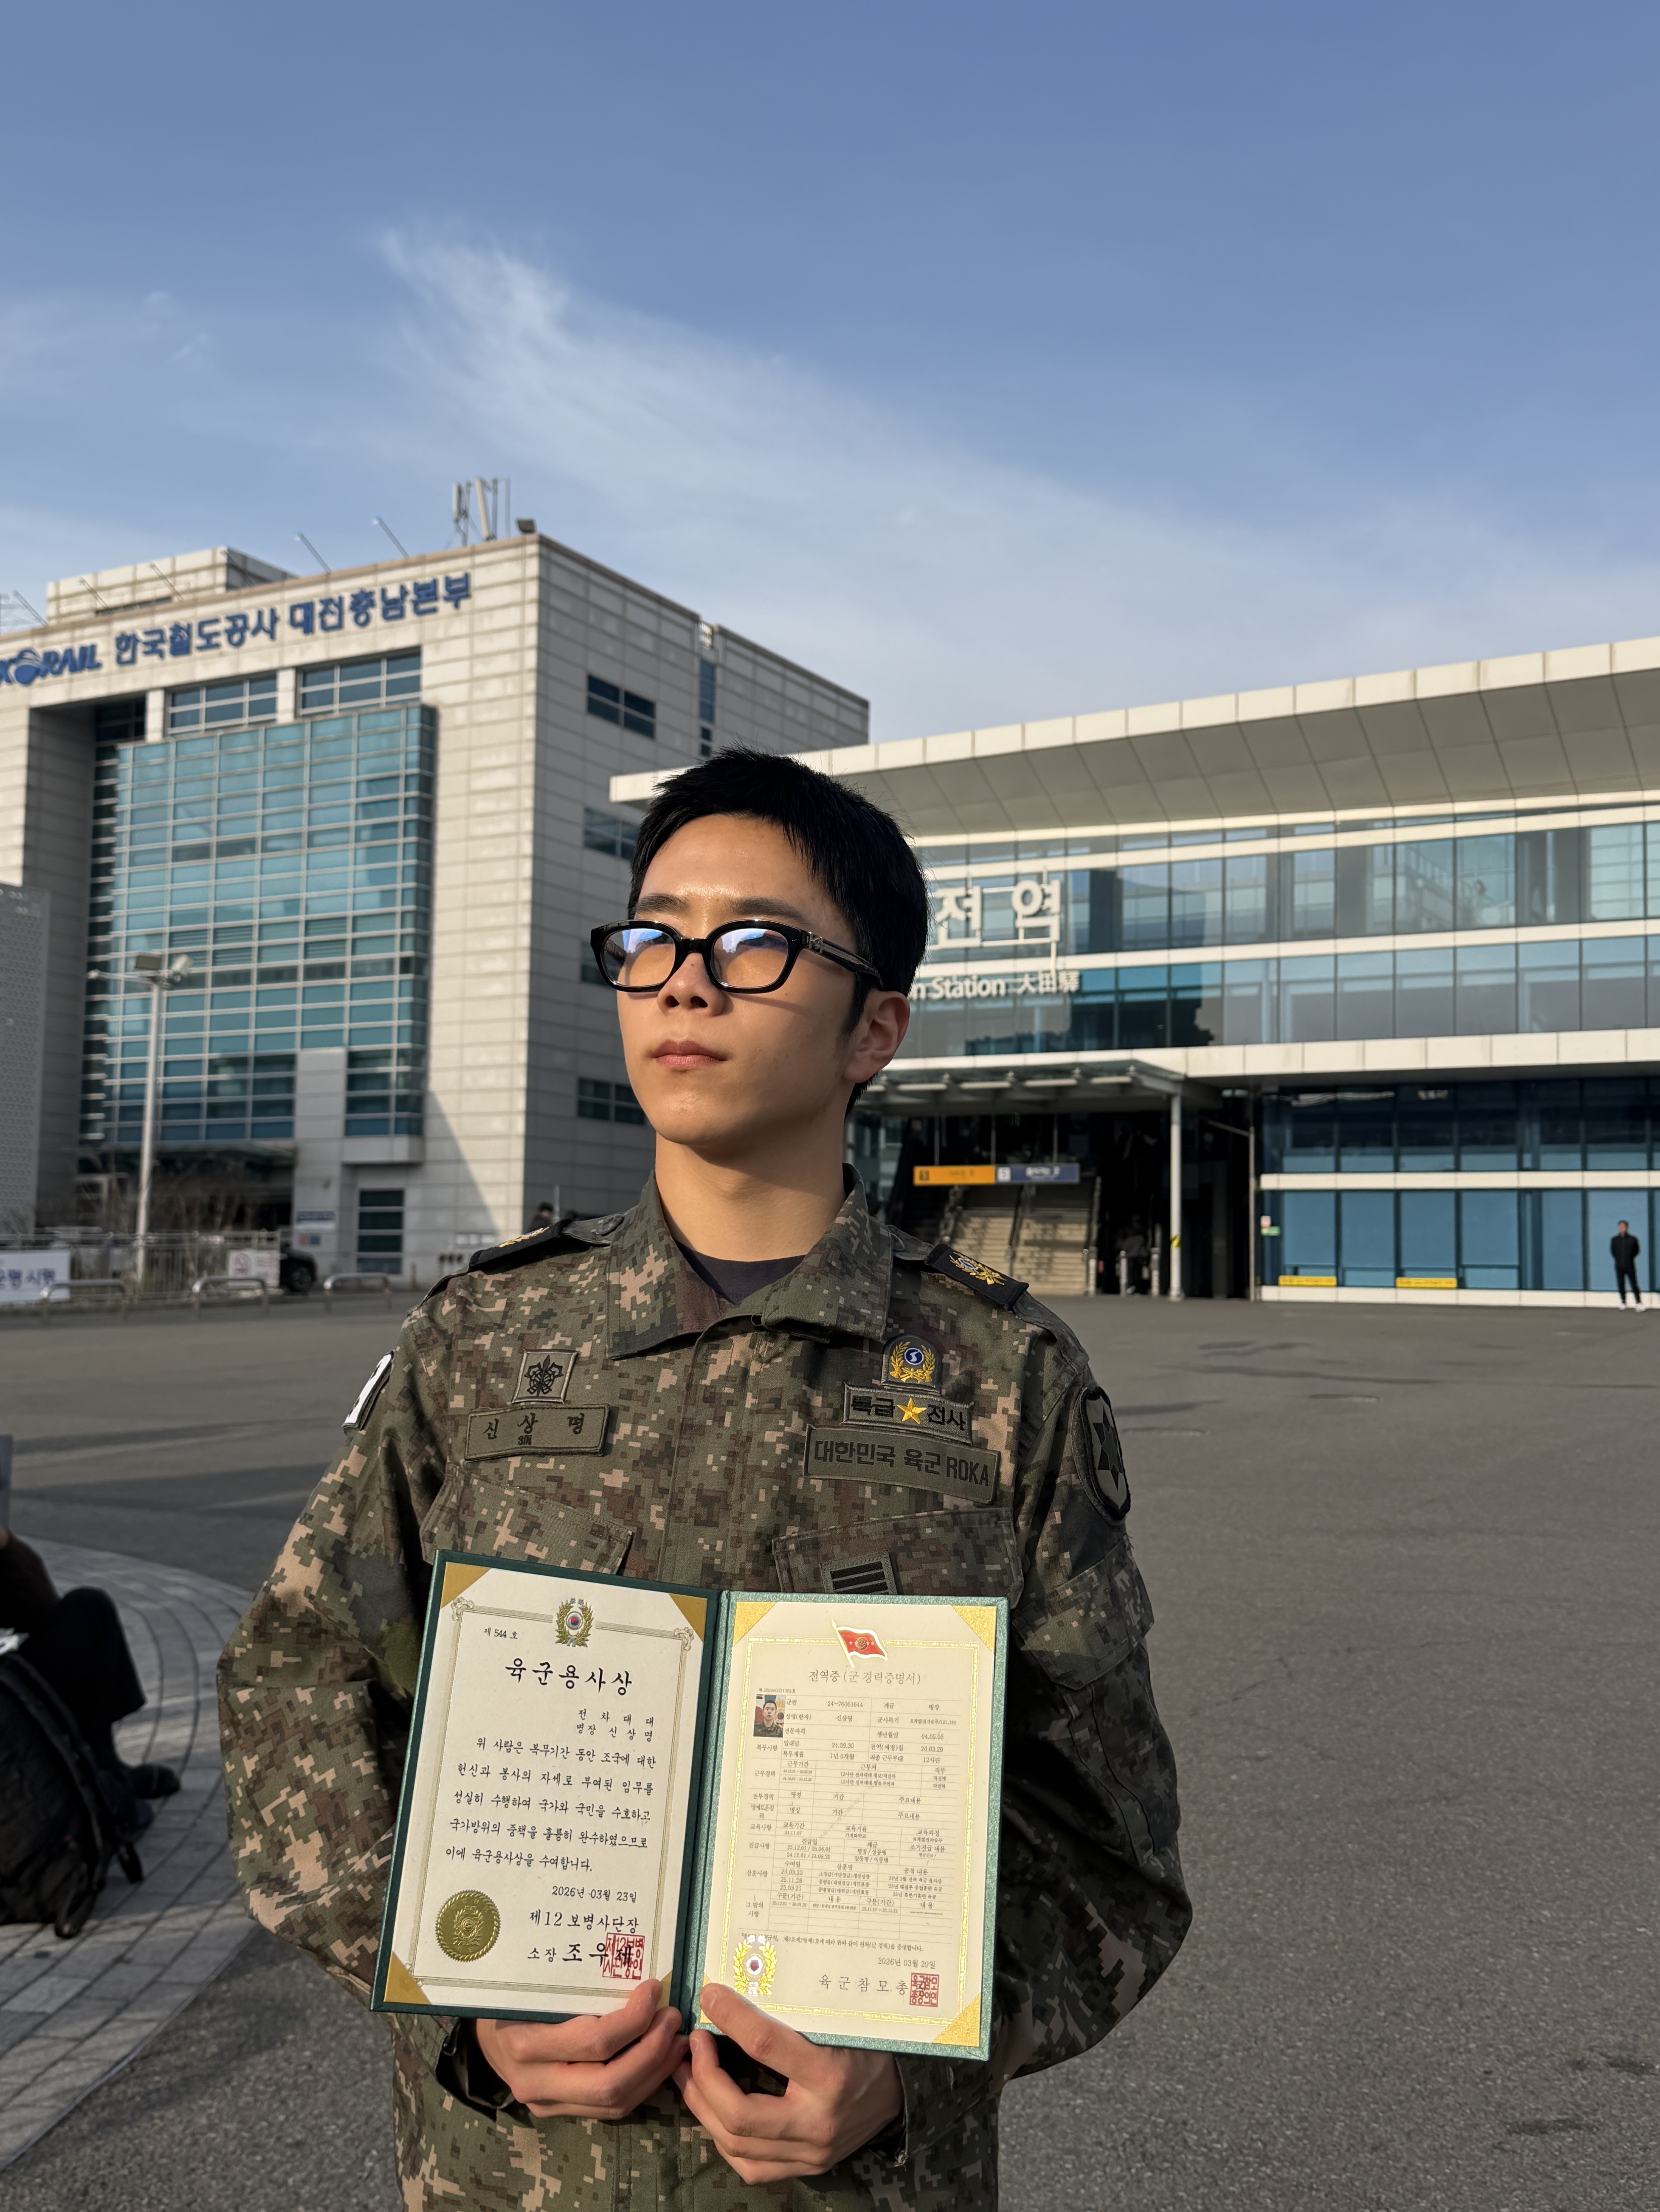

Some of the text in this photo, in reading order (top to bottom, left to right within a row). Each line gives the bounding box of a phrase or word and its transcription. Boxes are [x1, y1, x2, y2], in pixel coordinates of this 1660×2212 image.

[114, 609, 280, 667] 한국철도공사
[289, 572, 472, 636] 대전충남본부
[933, 879, 1061, 946] 전역
[930, 975, 1006, 1000] Station
[928, 1404, 966, 1431] 전사
[814, 1440, 989, 1487] 대한민국 육군 ROKA
[483, 1626, 491, 1636] 제
[510, 1630, 518, 1640] 호
[505, 1657, 632, 1696] 육군용사상
[809, 1670, 840, 1683] 전역증
[863, 1671, 921, 1685] 경력증명서)
[576, 1723, 596, 1736] 병장
[476, 1737, 656, 1769] 위 사람은 복무기간 동안 조국에 대한
[457, 1762, 654, 1795] 헌신과 봉사의 자세로 부여된 임무를
[453, 1790, 651, 1821] 성실히 수행하여 국가와 국민을 수호하고
[450, 1819, 648, 1849] 국가방위의 중책을 훌륭히 완수하였으므로
[446, 1846, 593, 1872] 이에 육군용사상을 수여합니다.
[552, 1885, 637, 1903] 2026년 03월 23일
[866, 1898, 894, 1906] 구분(기간)
[530, 1908, 639, 1934] 제12 보병사단장
[527, 1947, 557, 1963] 소장
[878, 1957, 936, 1969] 2026년 03월 29일
